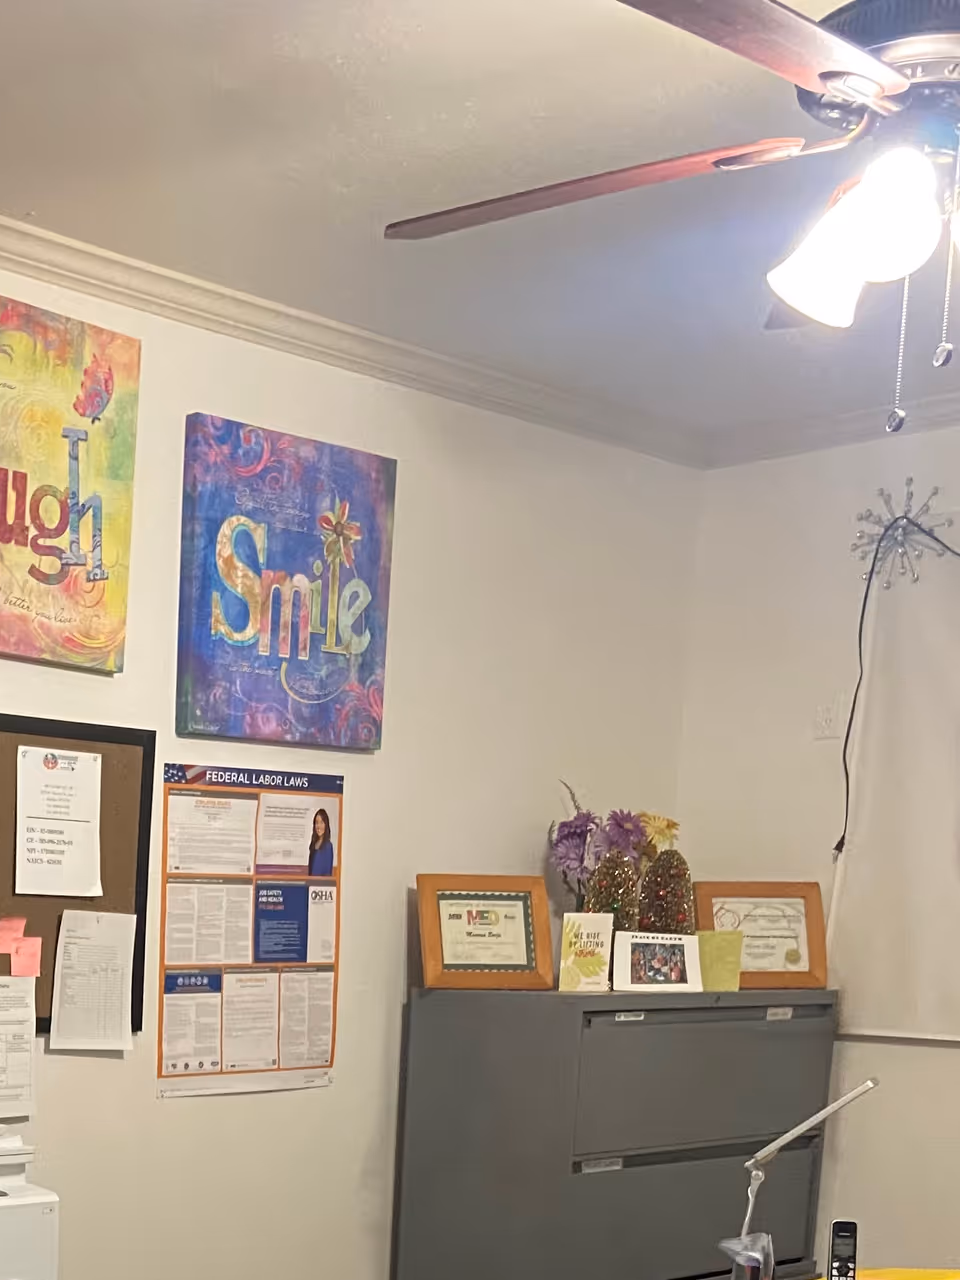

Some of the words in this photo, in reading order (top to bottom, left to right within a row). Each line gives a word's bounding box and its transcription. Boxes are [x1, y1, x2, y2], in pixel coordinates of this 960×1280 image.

[205, 770, 250, 784] FEDERAL
[252, 774, 283, 787] LABOR
[284, 776, 309, 788] LAWS
